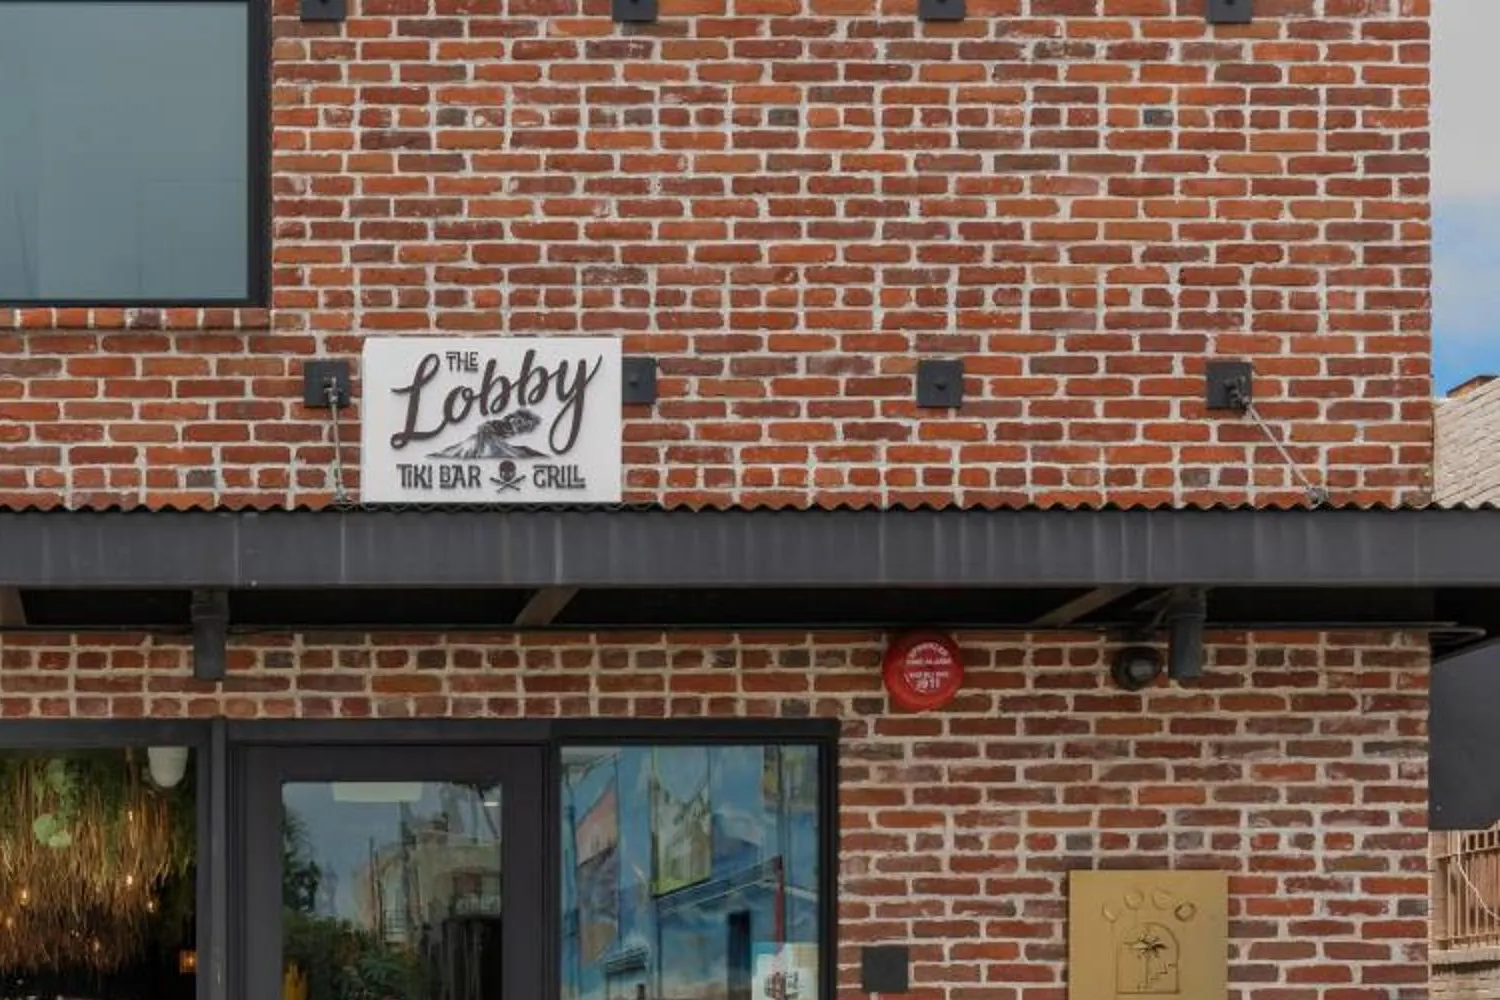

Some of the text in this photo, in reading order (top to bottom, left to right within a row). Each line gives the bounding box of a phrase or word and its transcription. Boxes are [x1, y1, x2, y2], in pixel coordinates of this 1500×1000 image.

[446, 351, 479, 372] THE
[391, 350, 603, 455] Lobby
[396, 463, 587, 489] TIKI BAR GRILL
